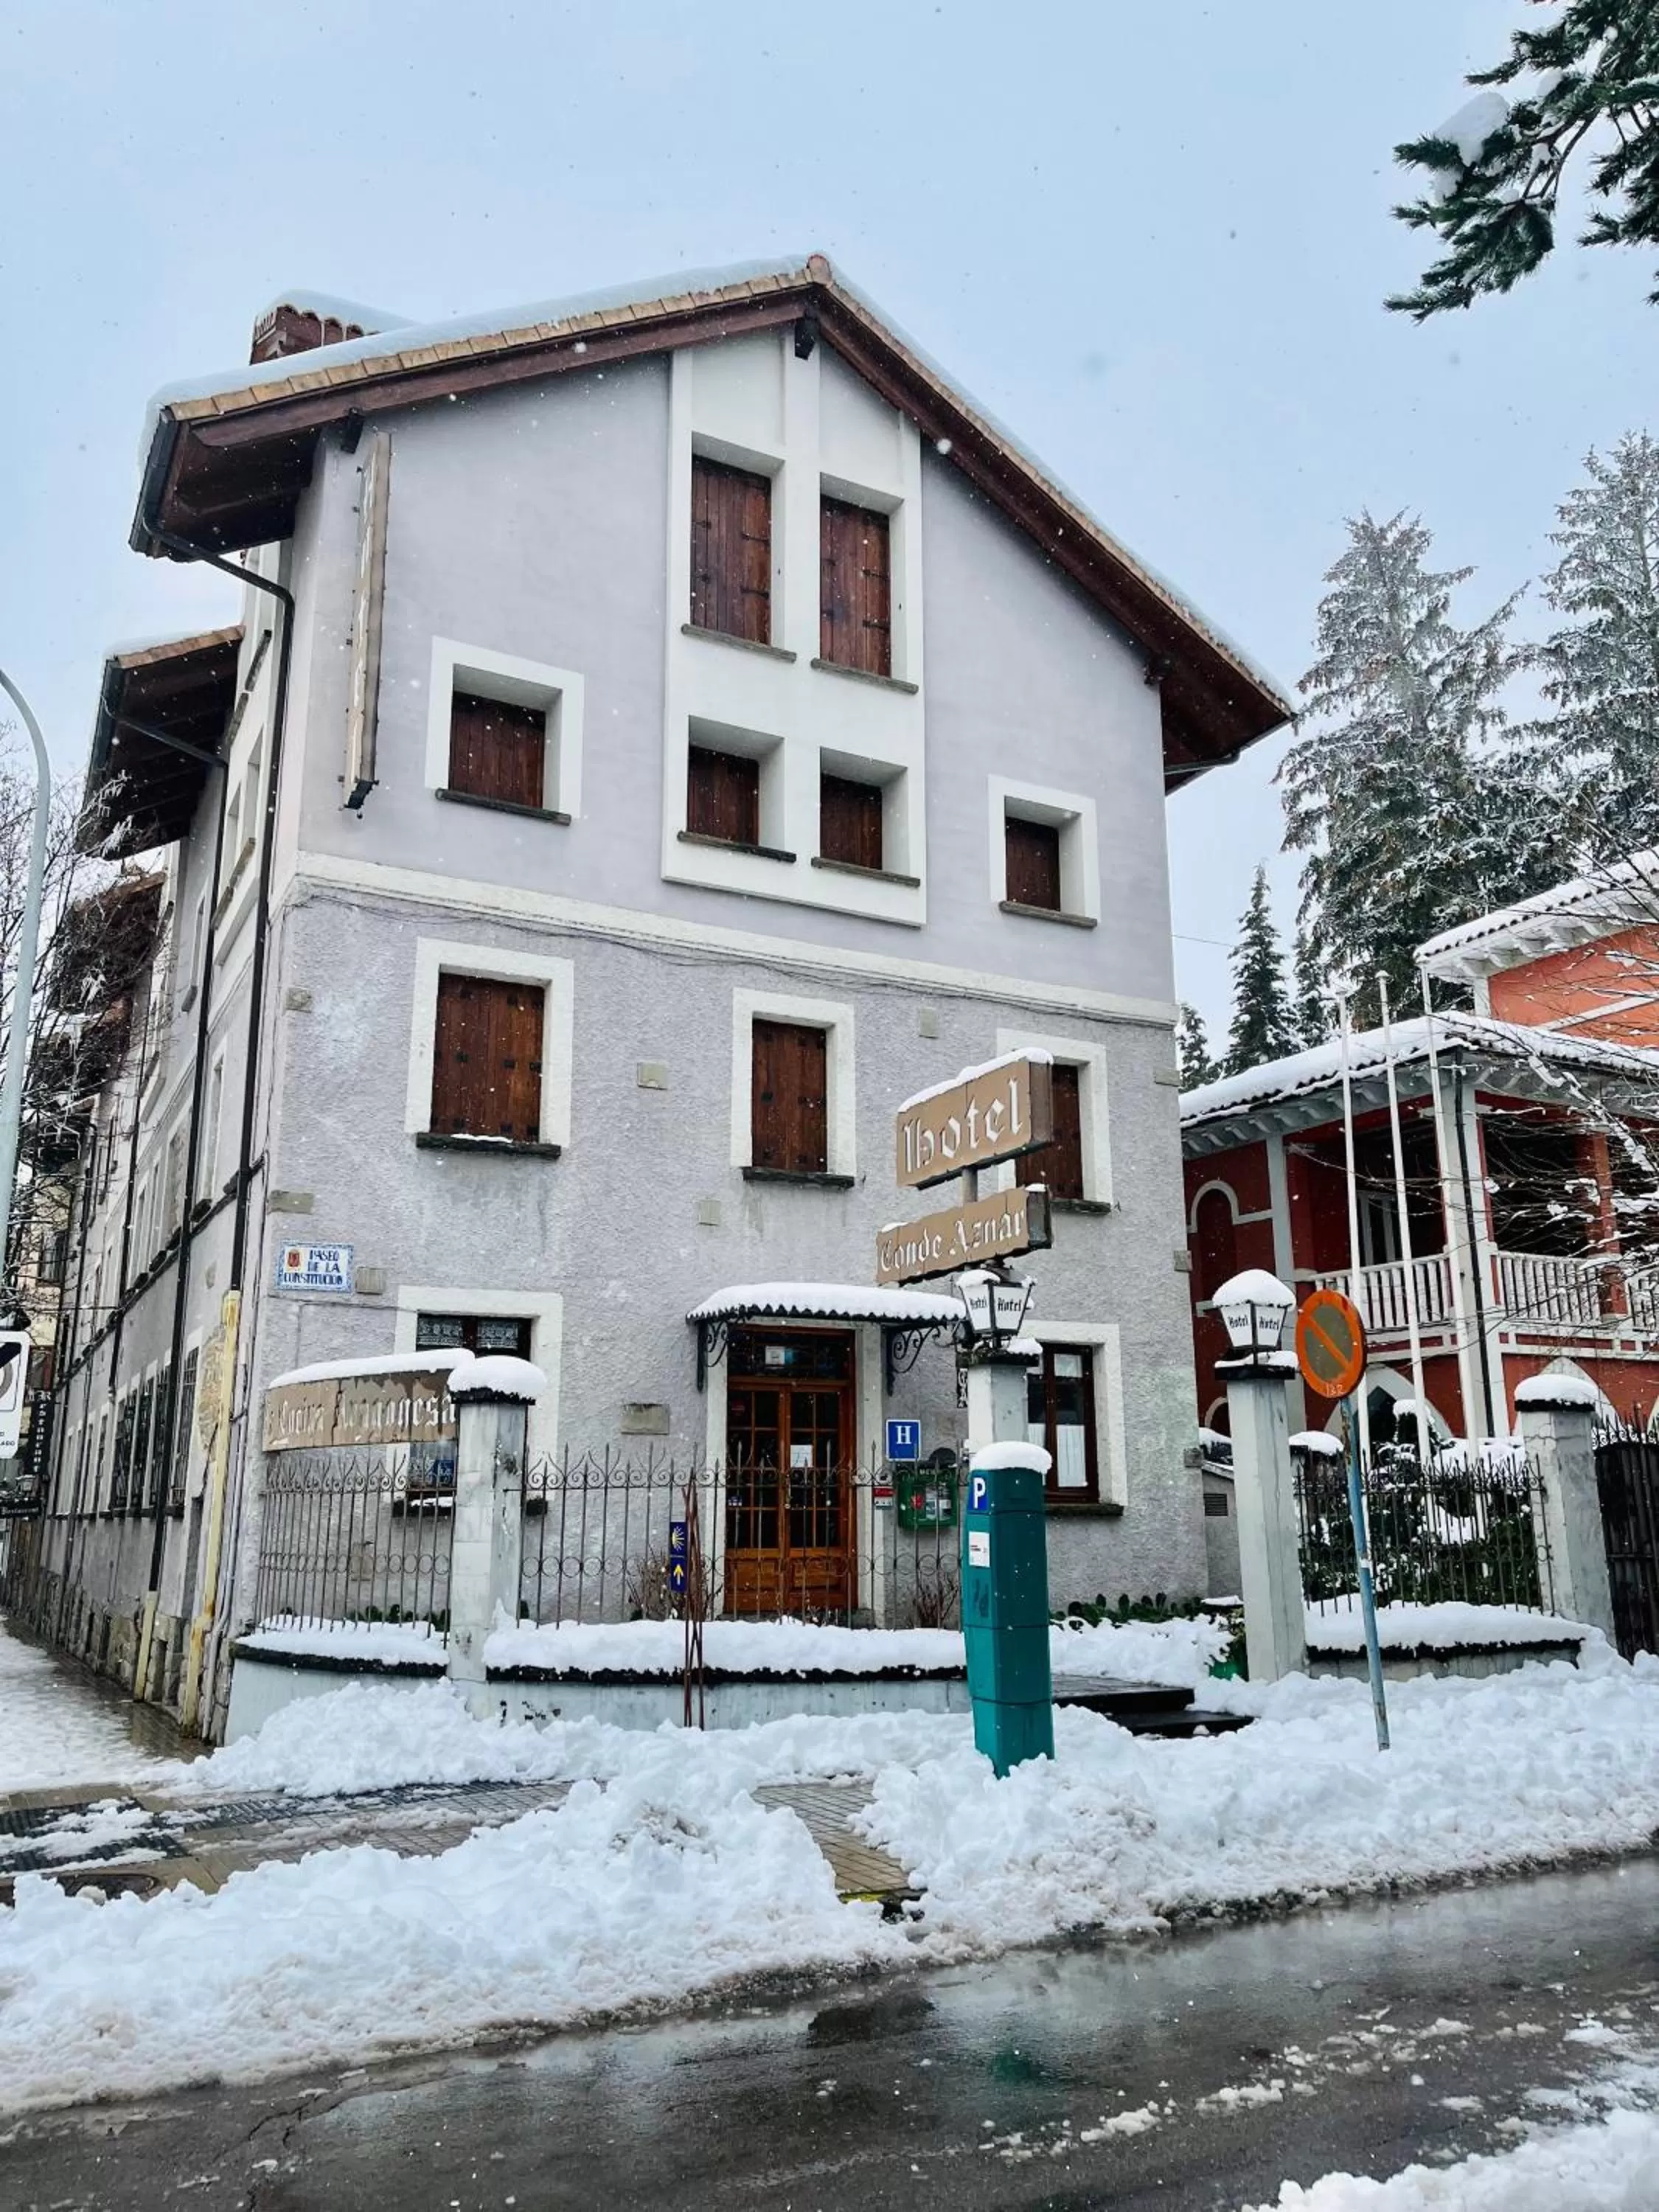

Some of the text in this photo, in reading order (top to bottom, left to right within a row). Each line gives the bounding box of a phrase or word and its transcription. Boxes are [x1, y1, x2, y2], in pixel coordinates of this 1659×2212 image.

[902, 1077, 1023, 1173] Hotel
[880, 1208, 1024, 1271] Conde Aznar
[309, 1250, 340, 1262] PASEO
[307, 1261, 340, 1273] DE LA
[998, 1297, 1022, 1312] Hotel
[1228, 1315, 1248, 1328] Hotel
[1259, 1316, 1280, 1330] Hotel
[895, 1425, 912, 1444] H
[973, 1477, 986, 1509] P
